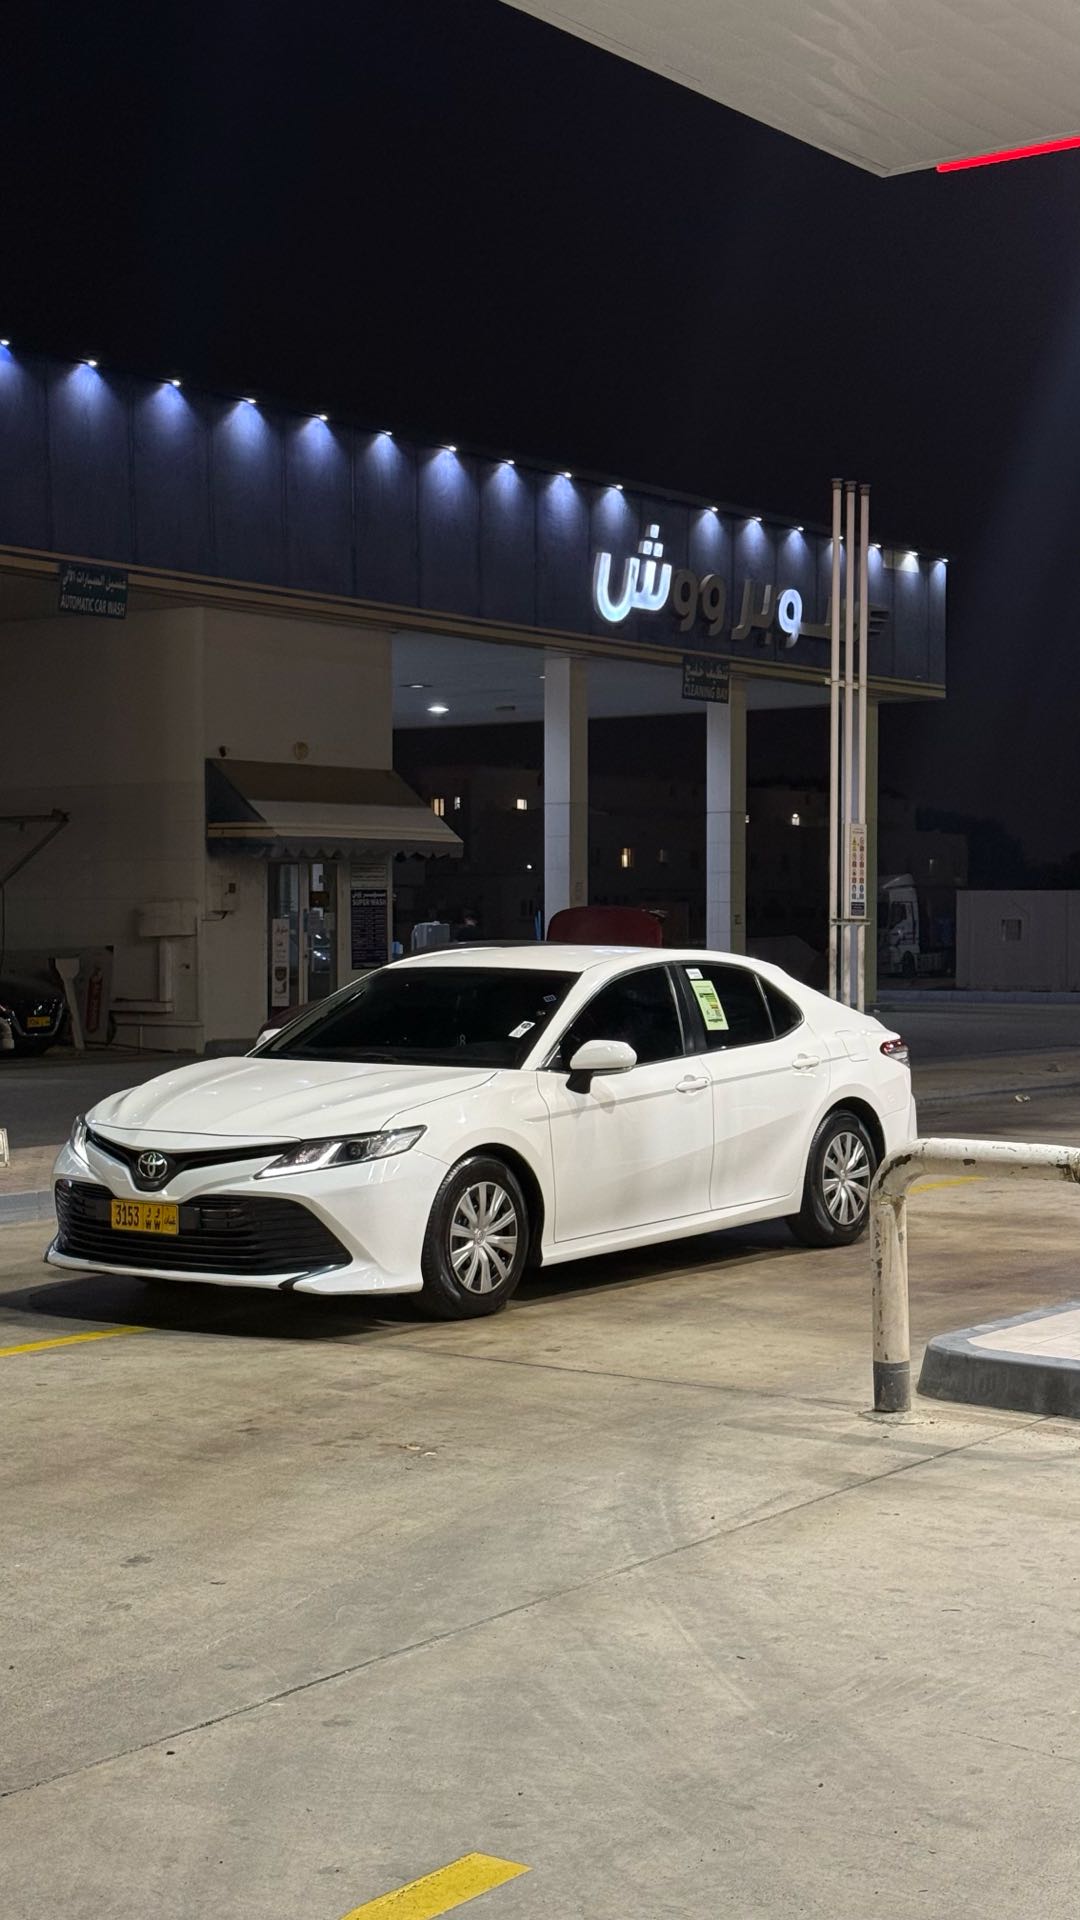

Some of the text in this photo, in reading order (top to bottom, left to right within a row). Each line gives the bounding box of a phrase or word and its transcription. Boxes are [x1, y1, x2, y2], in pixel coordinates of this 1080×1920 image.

[60, 593, 126, 617] AUTOMATIC CAR WASH
[684, 683, 716, 699] CLEANING
[352, 898, 386, 906] SUPER WASH
[115, 1203, 140, 1226] 3153
